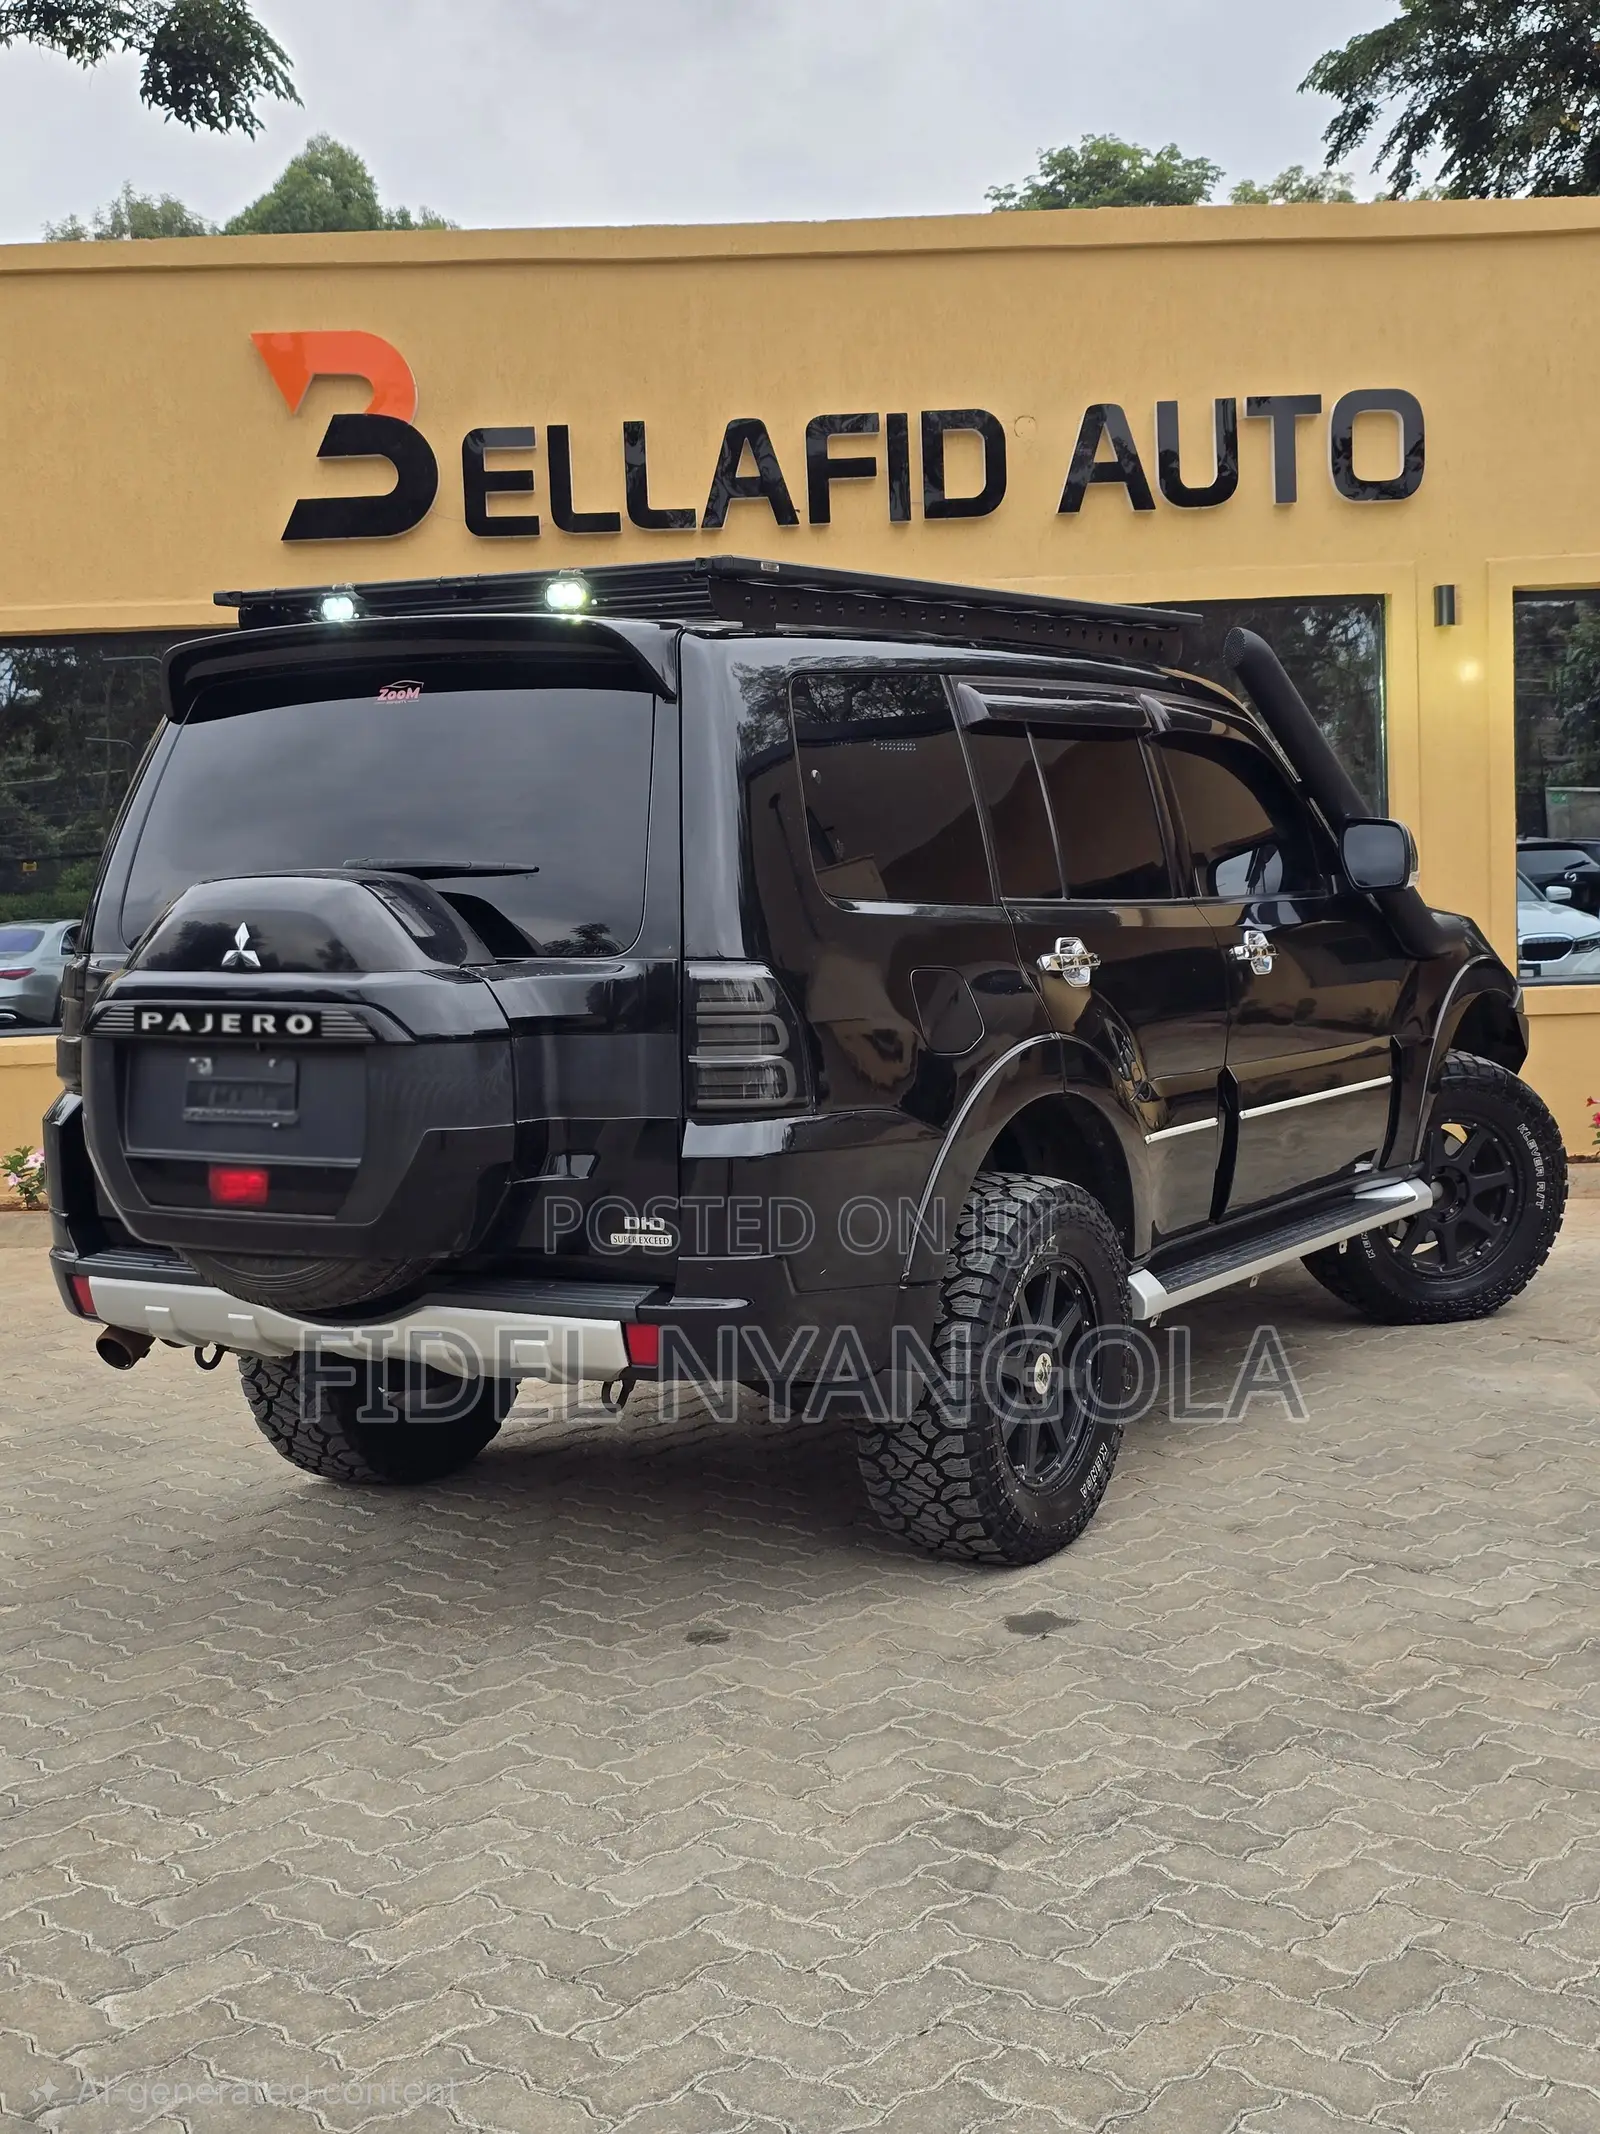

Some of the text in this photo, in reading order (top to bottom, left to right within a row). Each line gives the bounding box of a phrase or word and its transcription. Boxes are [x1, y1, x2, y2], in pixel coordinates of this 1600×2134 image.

[250, 330, 1426, 543] BELLAFID AUTO
[141, 1011, 313, 1035] PAJERO
[1517, 1123, 1546, 1210] KLEVER R/T
[612, 1235, 670, 1246] SUPER EXCEED
